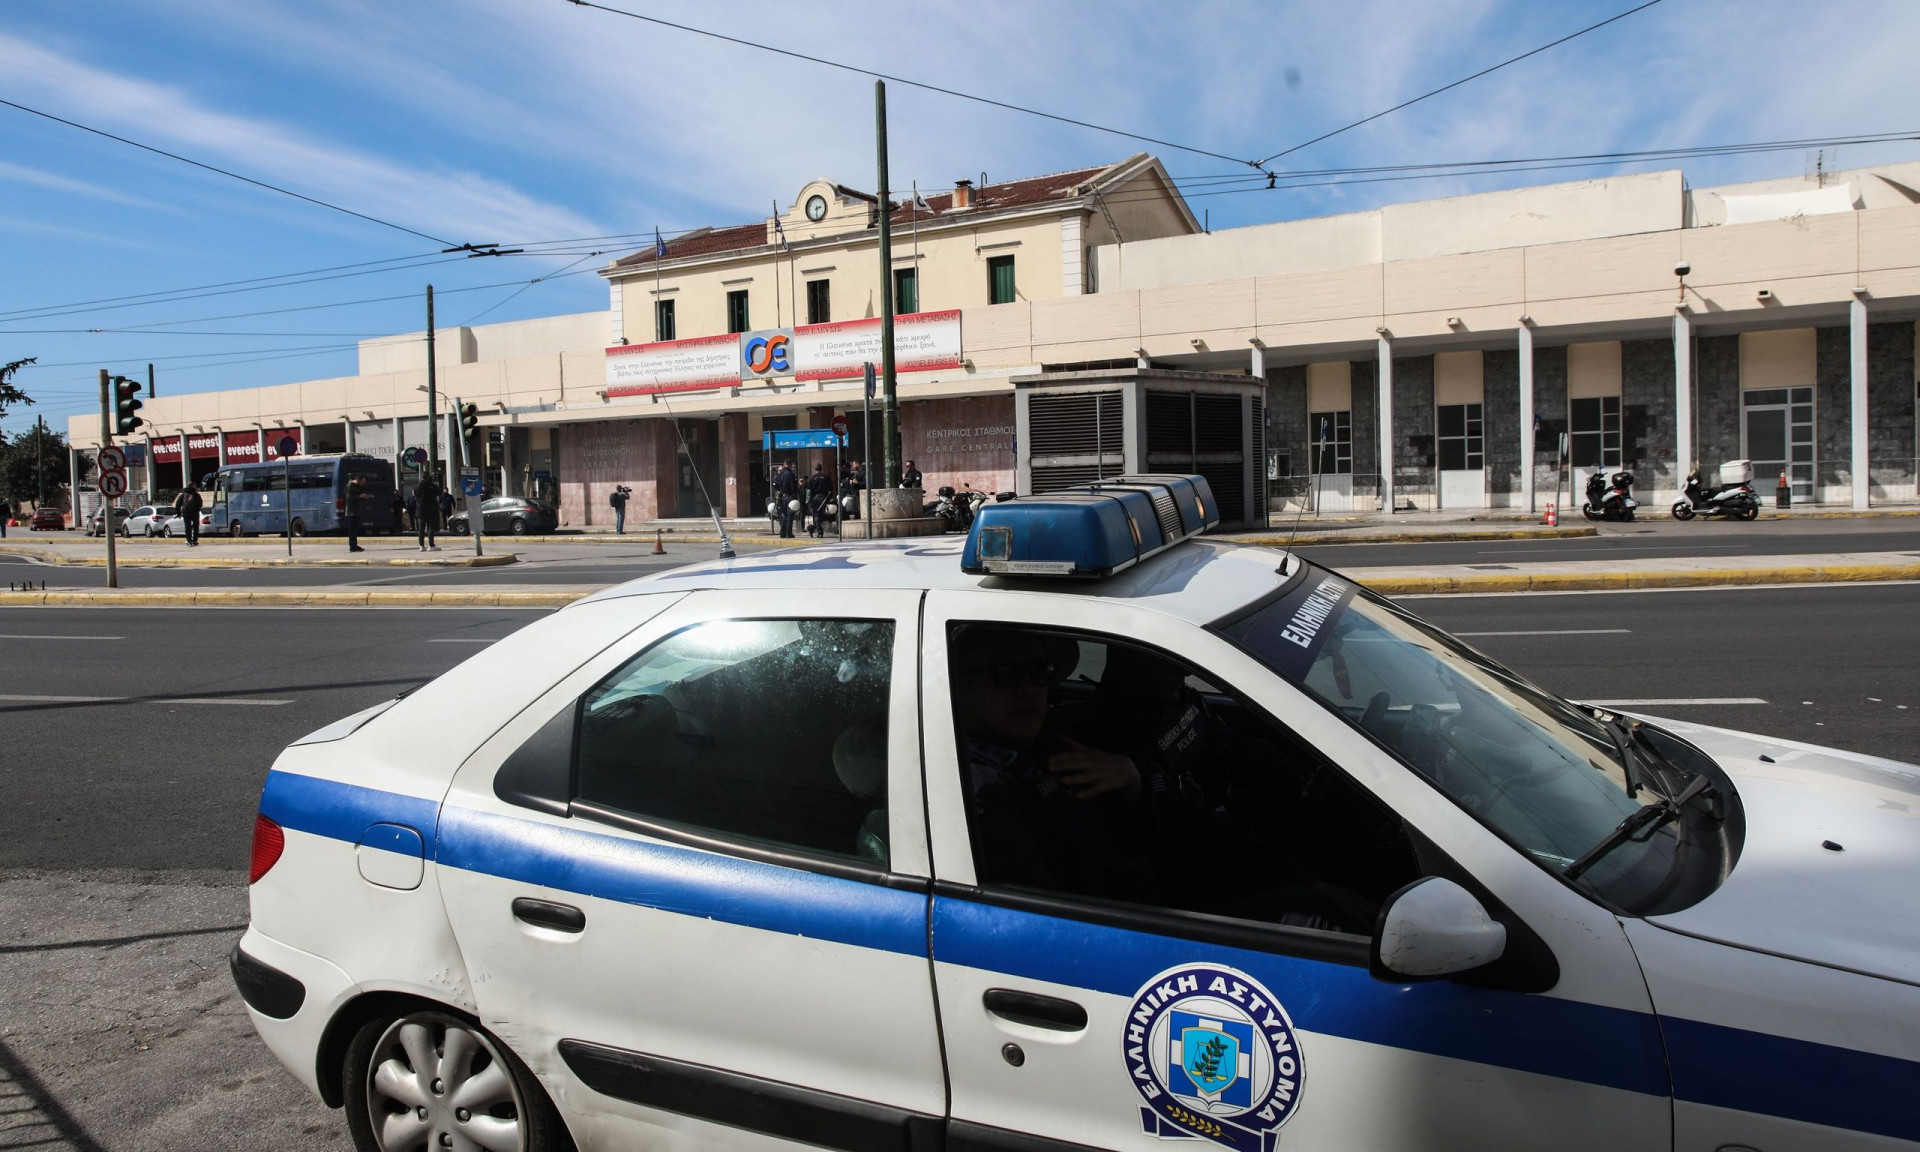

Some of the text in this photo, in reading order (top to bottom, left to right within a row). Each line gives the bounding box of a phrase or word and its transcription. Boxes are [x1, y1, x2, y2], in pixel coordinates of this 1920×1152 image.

[916, 312, 958, 323] ΜΕΤΑΒΑΣΗΣ
[795, 328, 810, 337] 2023
[795, 368, 830, 377] EUROPEAN
[830, 366, 856, 375] CAPITAL
[926, 426, 1015, 439] ΚΕΝΤΡΙΚΟΣ ΣΤΑΘΜΟΣ
[153, 440, 182, 454] everest
[189, 435, 219, 449] everest
[227, 442, 260, 456] everest
[926, 445, 954, 453] GARE
[1280, 593, 1335, 649] ΕΛΛΗΝΙΚΗ
[1128, 974, 1296, 1122] ΕΛΛΗΝΙΚΗ ΑΣΤΥΝΟΜΙΑ
